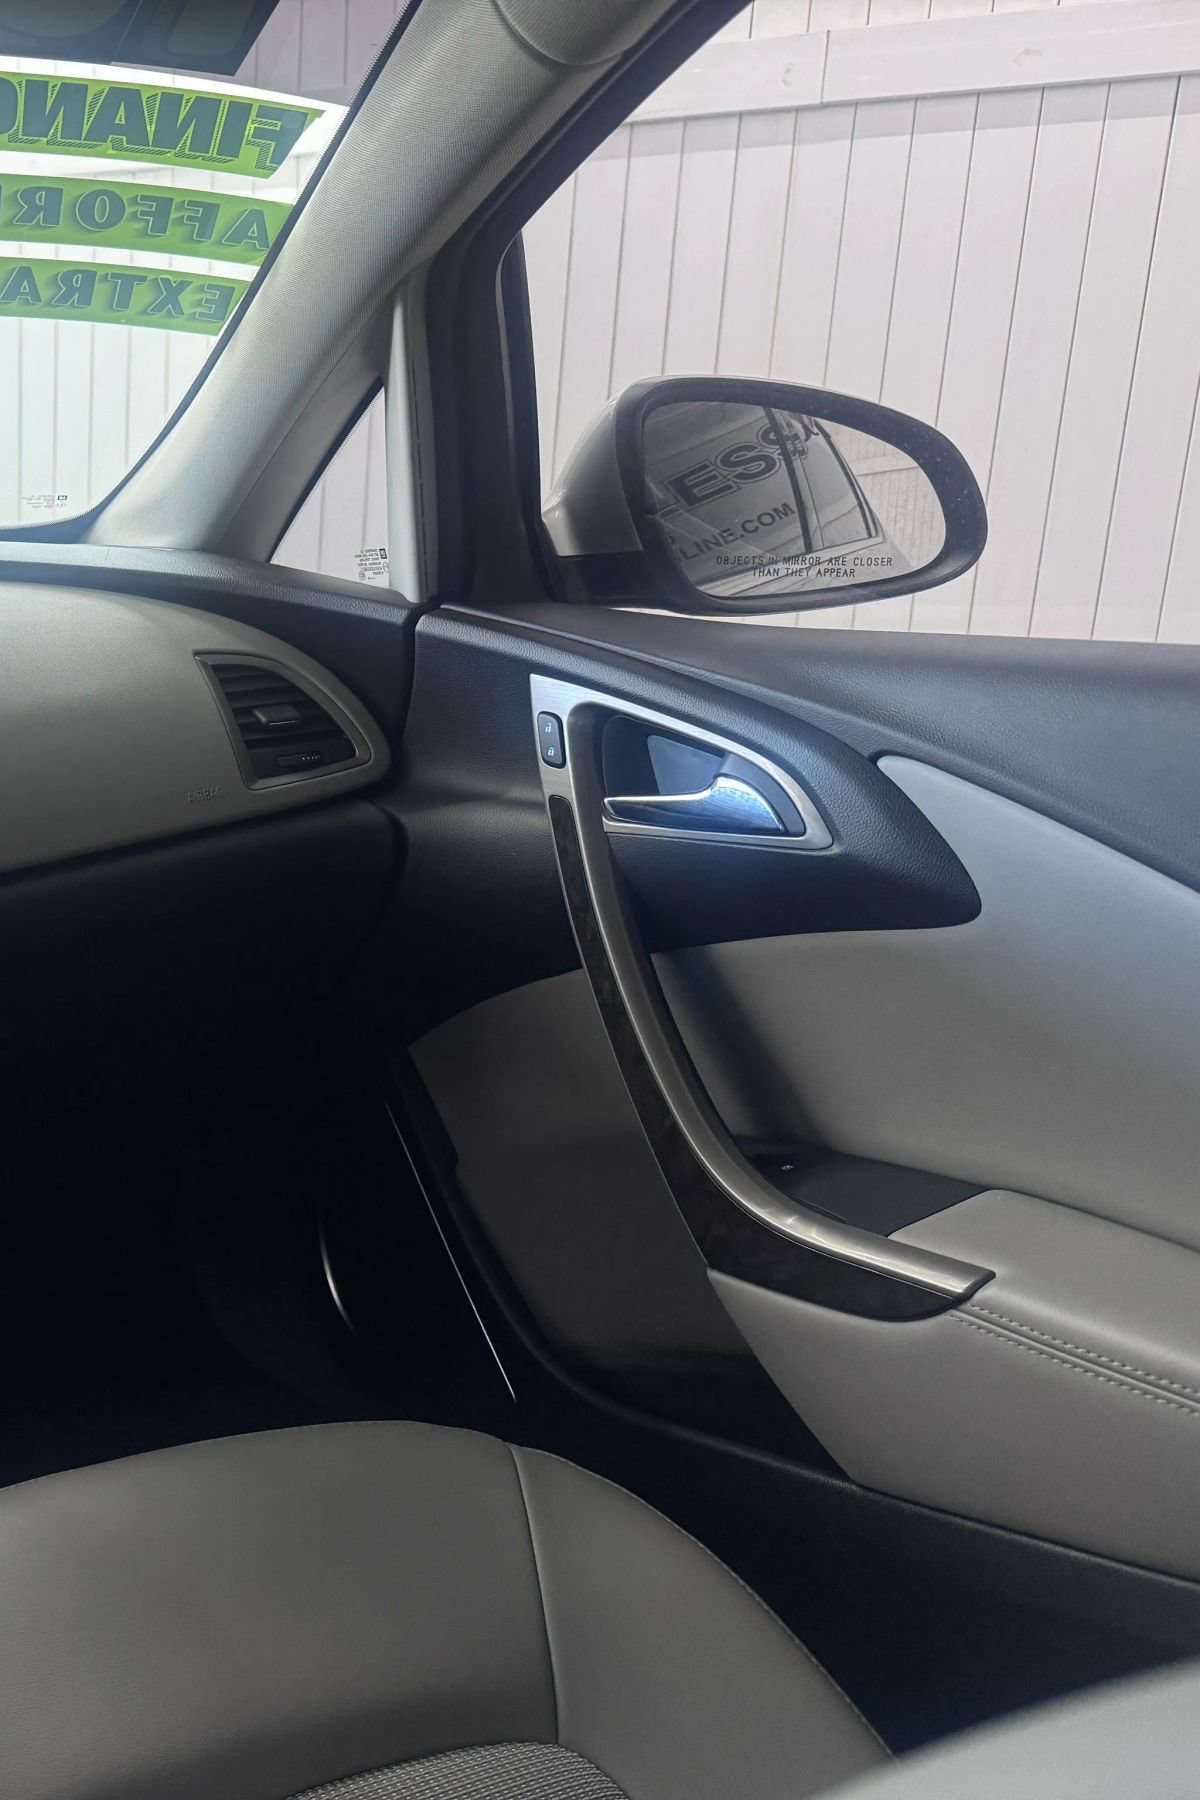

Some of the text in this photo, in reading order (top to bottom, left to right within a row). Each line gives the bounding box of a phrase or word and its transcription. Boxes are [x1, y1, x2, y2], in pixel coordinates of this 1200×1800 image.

[716, 556, 893, 567] OBJECTS IN MIRROR ARE CLOSER
[753, 567, 856, 578] THAN THEY APPEAR
